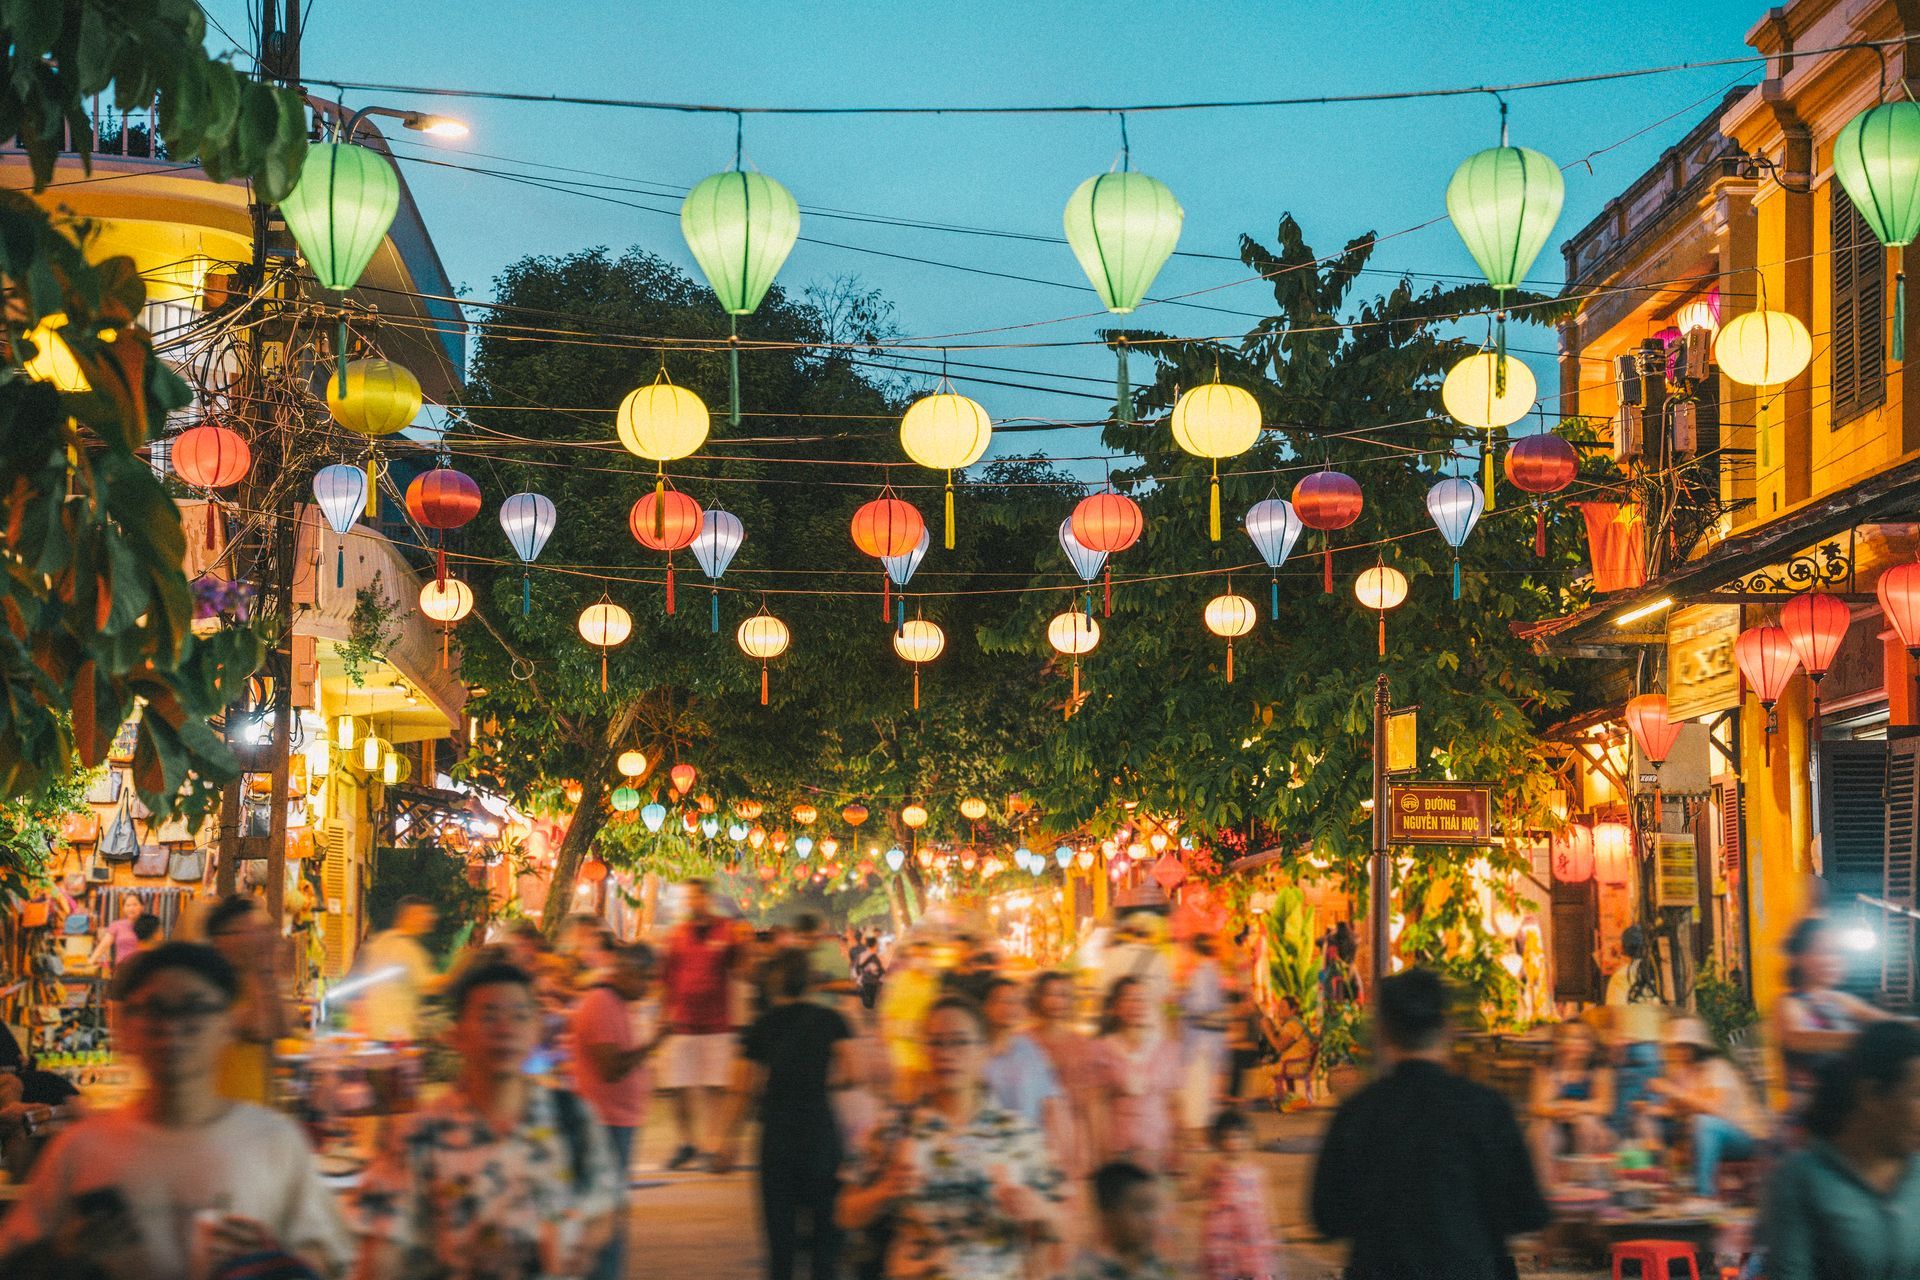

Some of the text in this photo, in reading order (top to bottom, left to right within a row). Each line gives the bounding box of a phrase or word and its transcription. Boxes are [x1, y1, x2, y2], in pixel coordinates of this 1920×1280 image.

[1424, 795, 1456, 811] ĐƯỜNG
[1403, 811, 1479, 833] NGUYỄN THÁI HỌC
